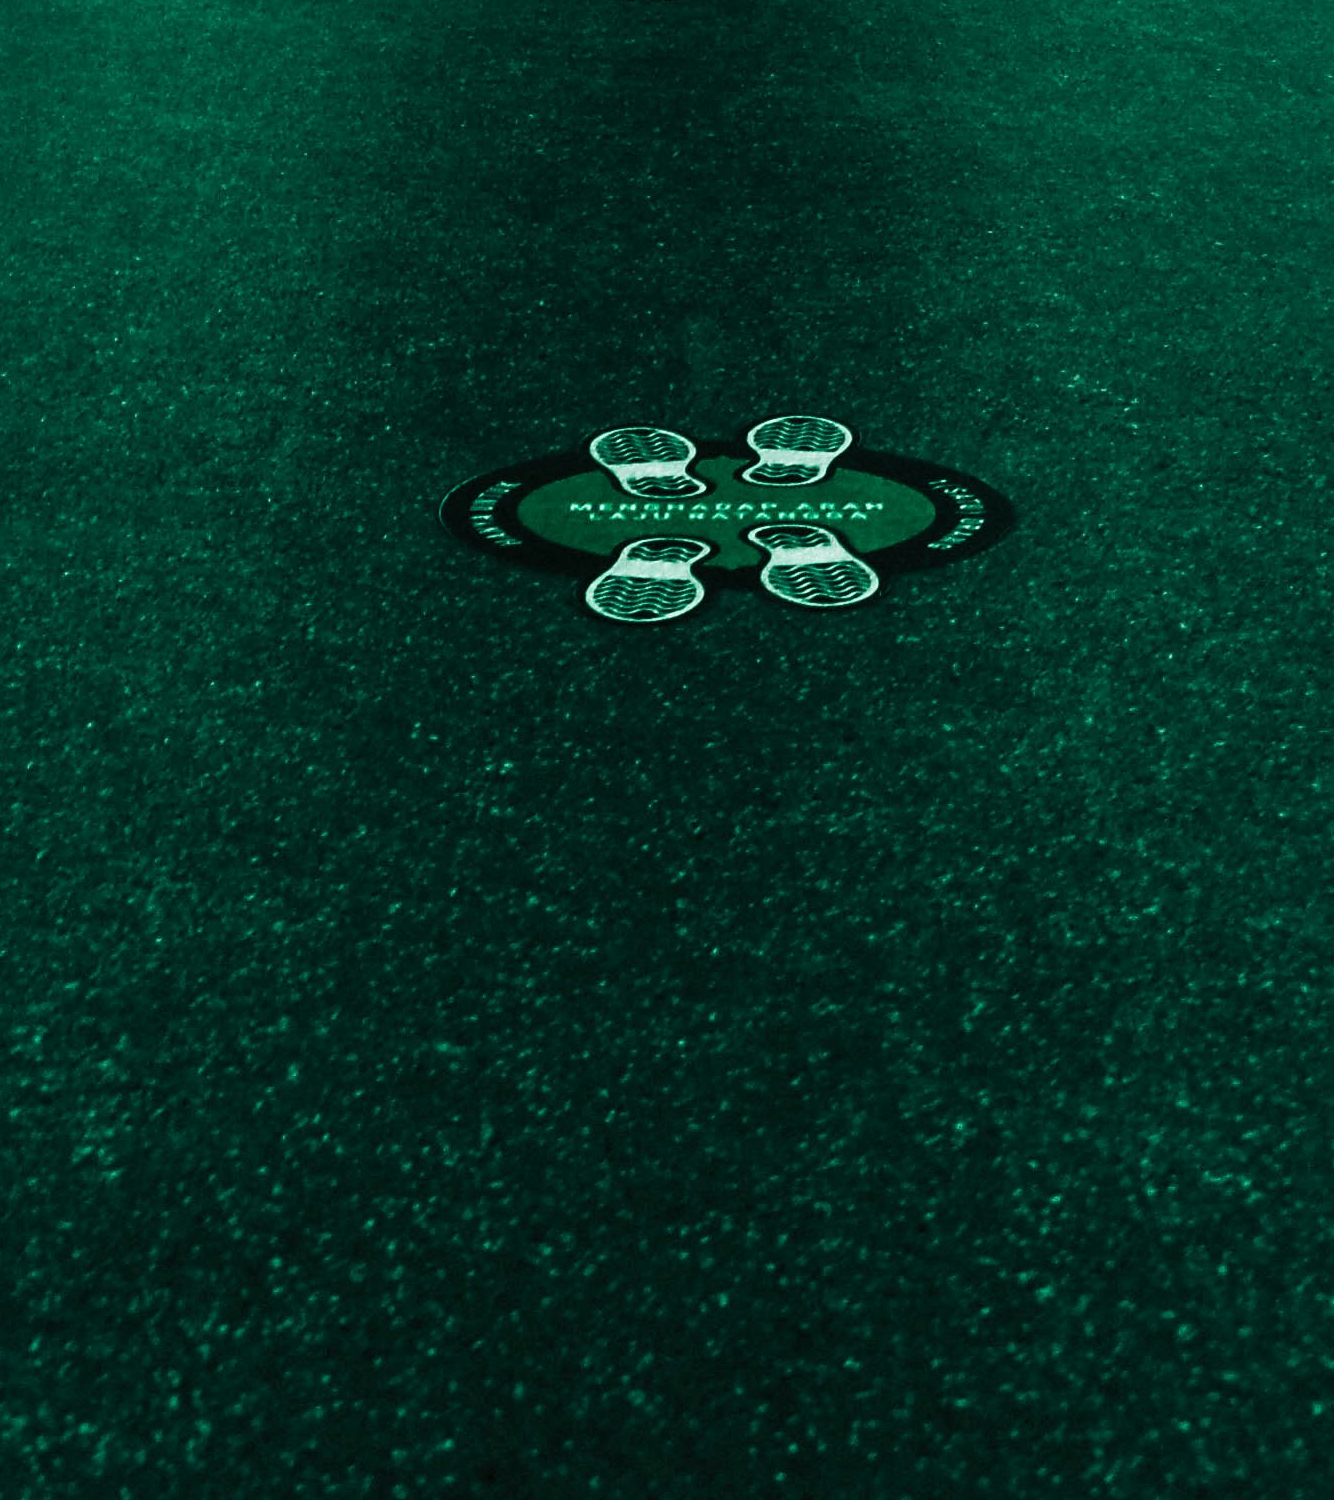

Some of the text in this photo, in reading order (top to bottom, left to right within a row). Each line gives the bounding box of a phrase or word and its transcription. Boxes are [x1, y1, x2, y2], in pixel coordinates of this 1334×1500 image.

[569, 502, 886, 512] MENGHADAP ARAH
[588, 511, 673, 521] LAJU
